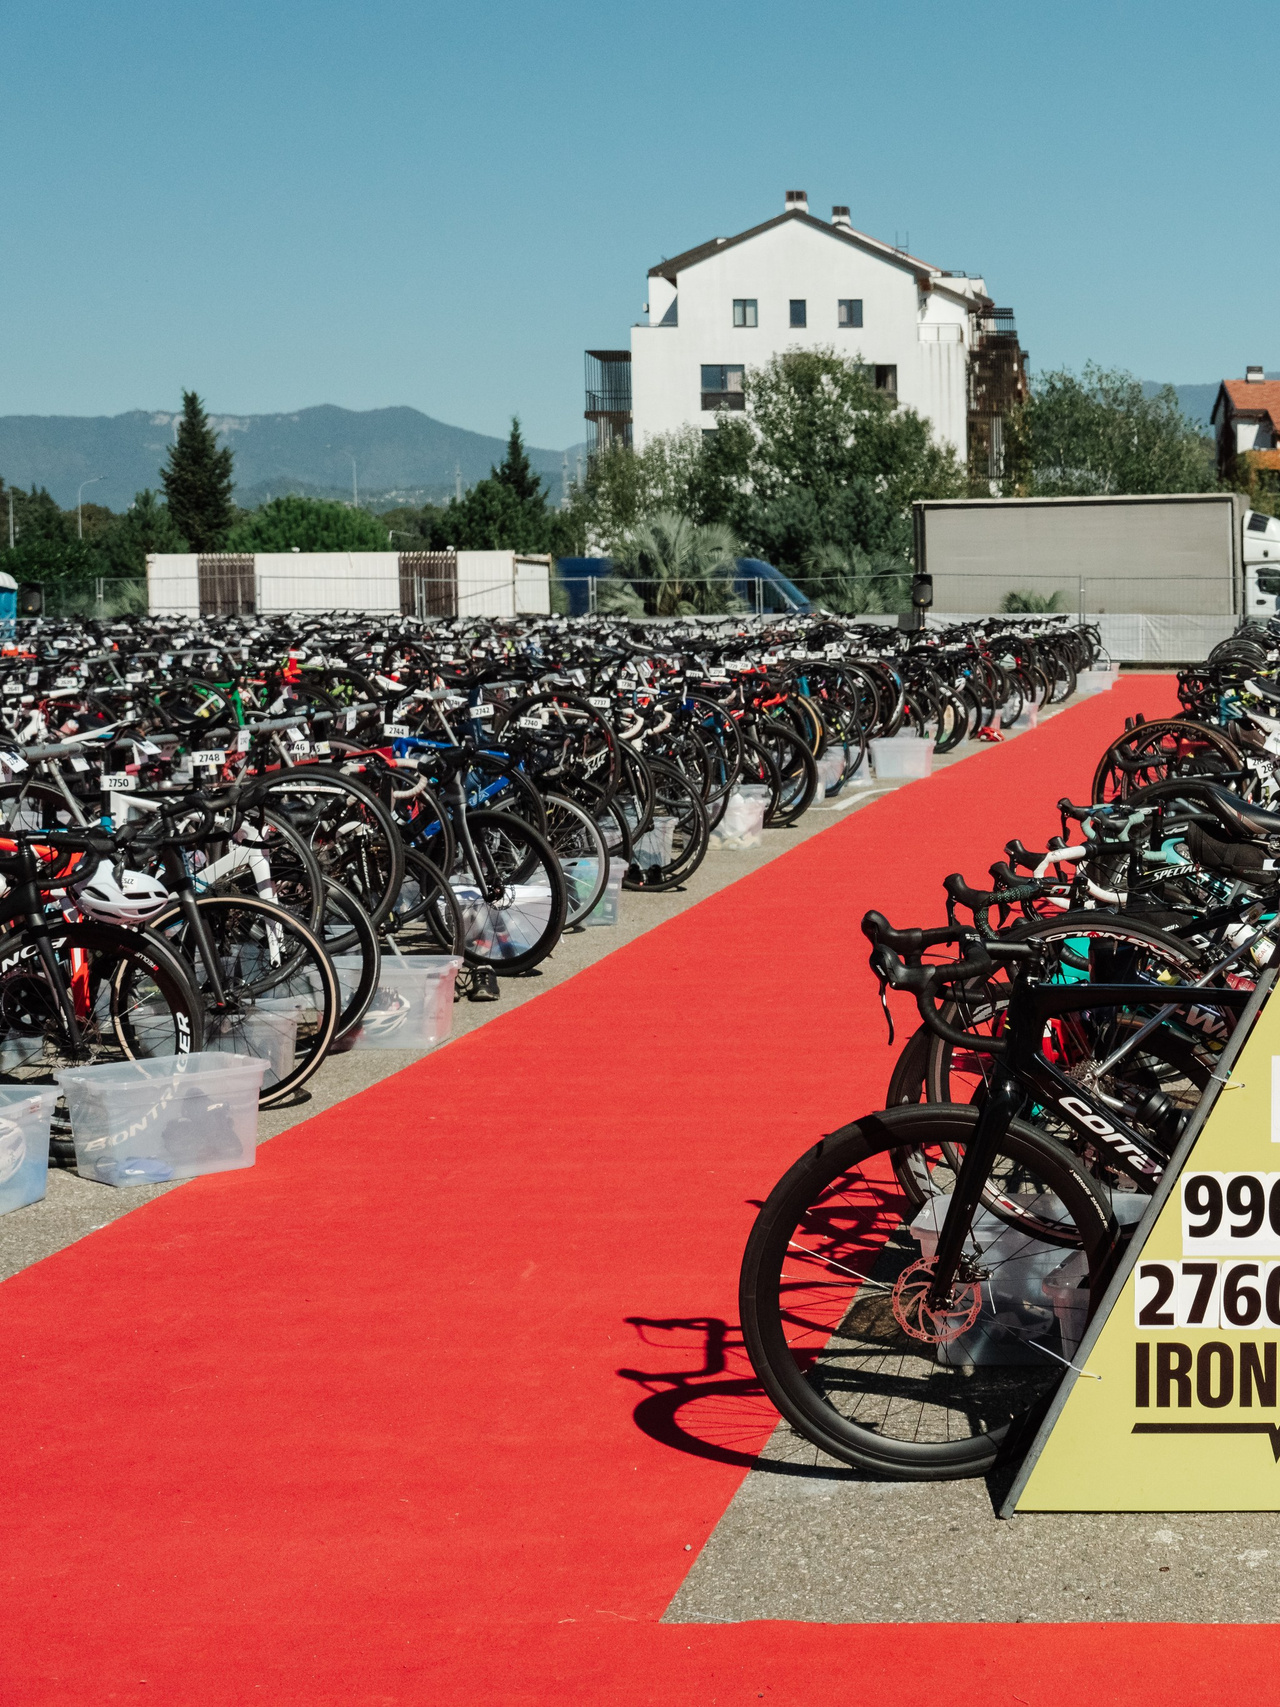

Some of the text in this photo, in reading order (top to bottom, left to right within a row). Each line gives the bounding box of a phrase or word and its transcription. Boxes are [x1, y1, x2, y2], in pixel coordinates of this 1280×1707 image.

[475, 707, 489, 715] 2742
[523, 719, 538, 727] 2740
[388, 727, 404, 735] 2744
[198, 753, 219, 763] 2748
[108, 778, 128, 788] 2750
[1135, 1341, 1278, 1408] IRON
